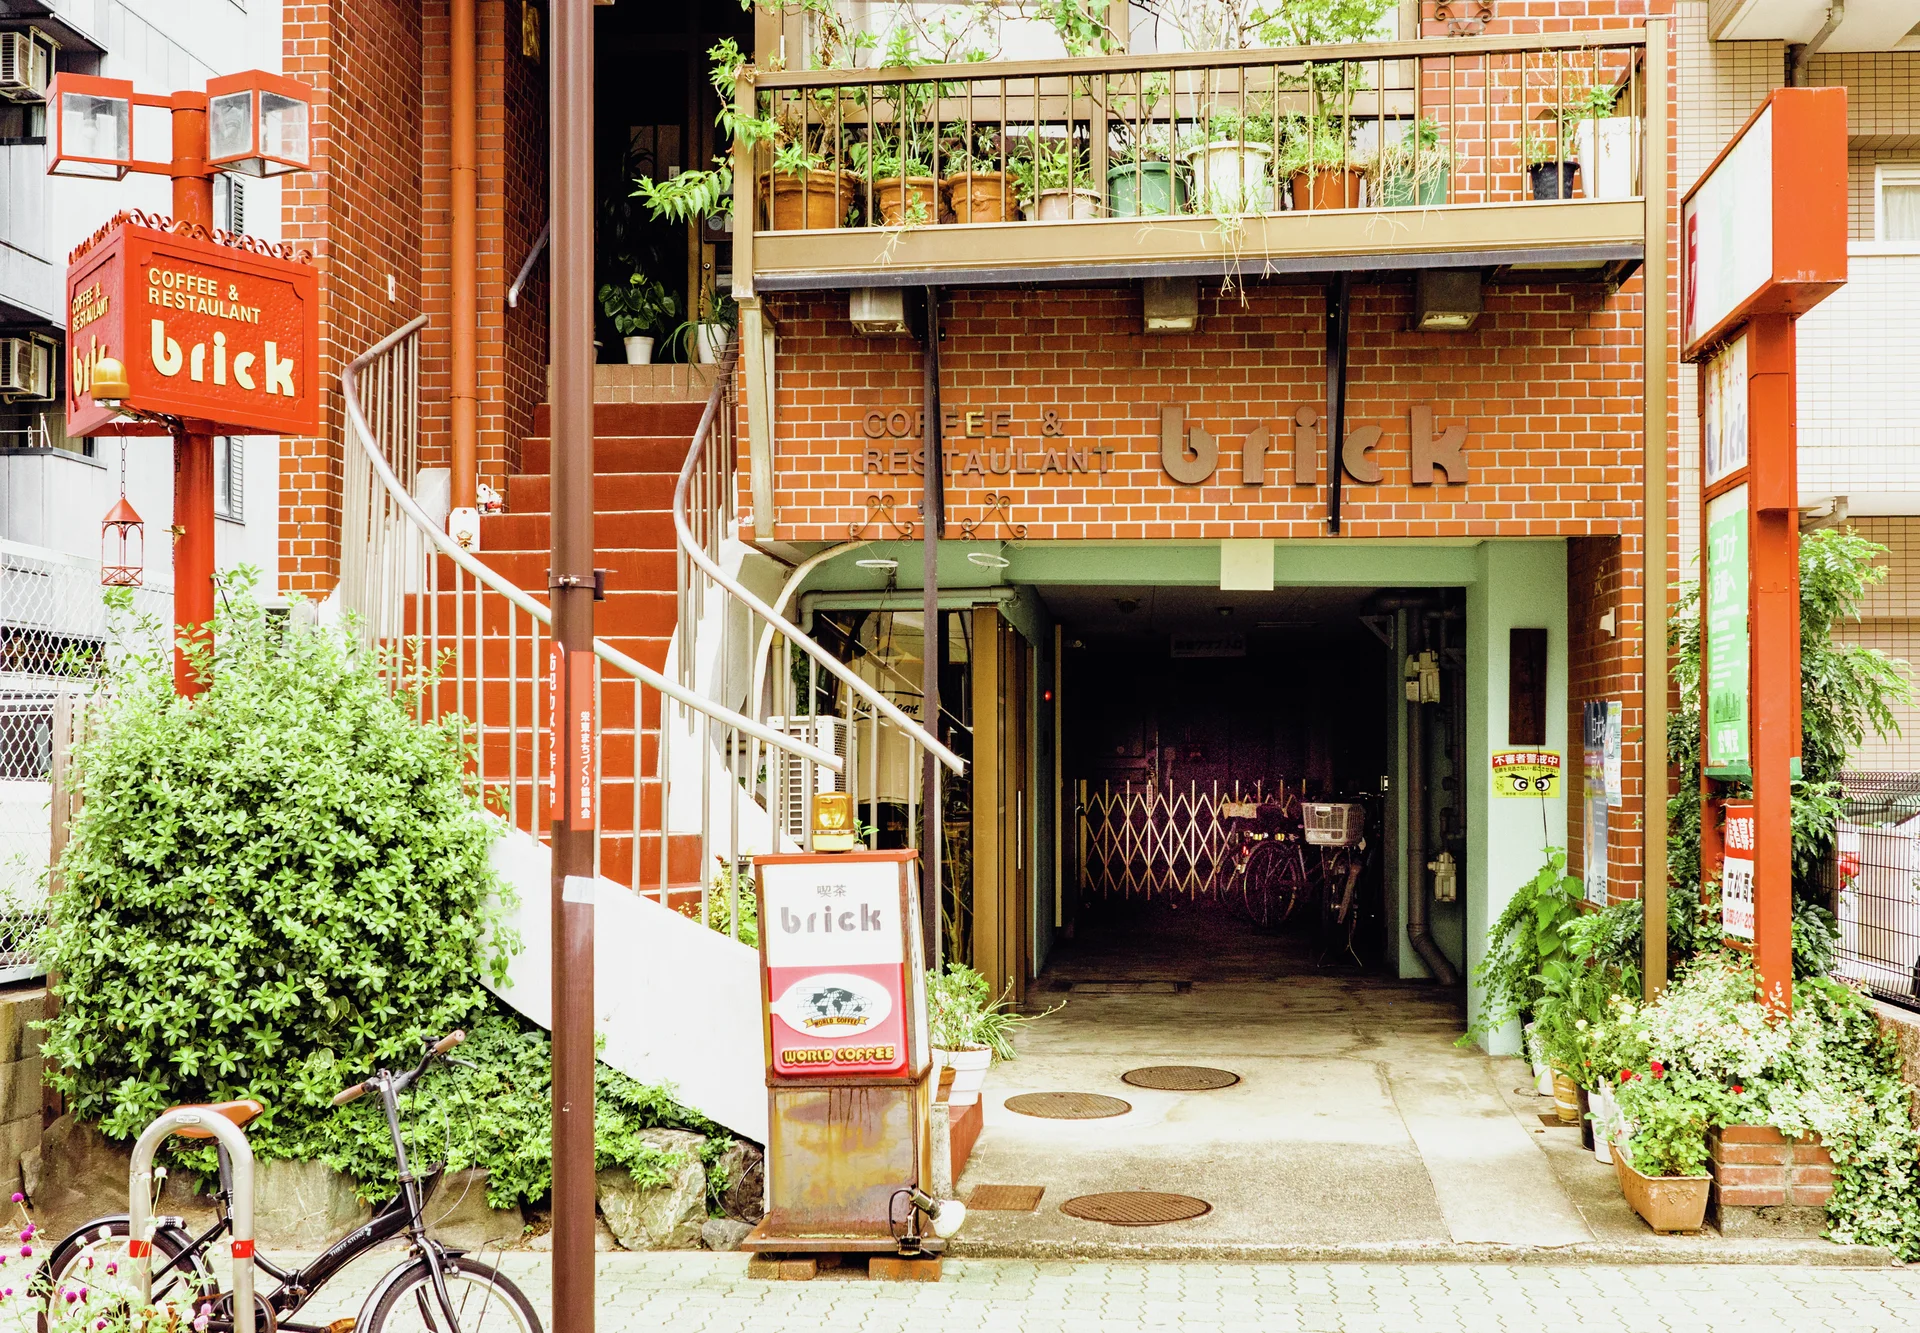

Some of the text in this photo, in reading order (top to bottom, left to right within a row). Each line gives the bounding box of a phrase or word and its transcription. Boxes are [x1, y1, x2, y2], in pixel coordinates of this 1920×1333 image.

[72, 282, 101, 314] COFFEE &
[148, 267, 240, 301] COFFEE &
[148, 287, 262, 325] RESTAULANT
[151, 318, 296, 398] brick
[1041, 409, 1065, 437] &
[862, 446, 1114, 476] RESTAULANT
[1161, 405, 1469, 487] brick
[1494, 753, 1559, 766] 不審者警戒中
[816, 884, 847, 898] 喫茶
[780, 902, 882, 934] brick
[814, 1016, 859, 1027] WORLD COFFEE
[783, 1046, 895, 1064] WORLD COFFEE
